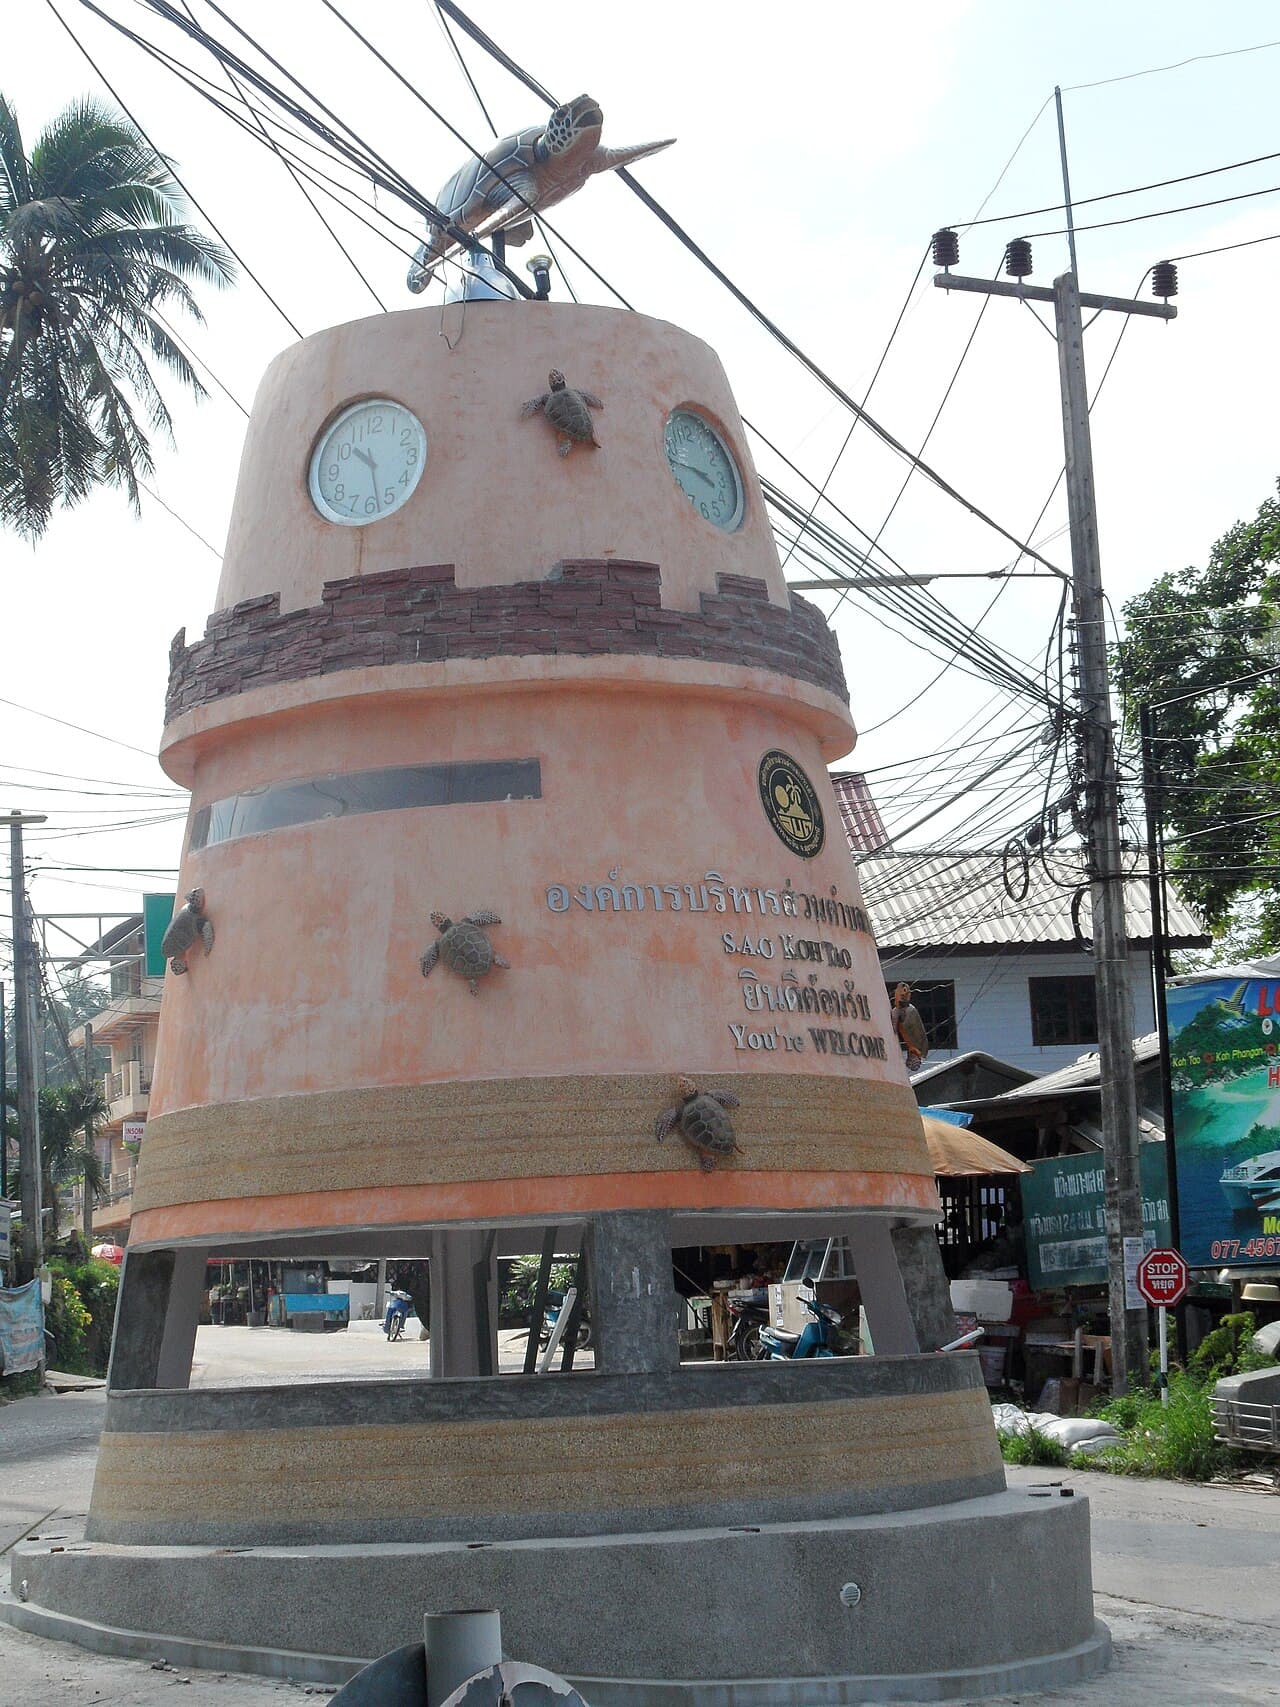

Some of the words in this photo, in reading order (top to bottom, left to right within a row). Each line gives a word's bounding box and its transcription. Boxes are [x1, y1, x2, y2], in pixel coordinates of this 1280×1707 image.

[351, 424, 364, 443] 11
[367, 415, 384, 435] 12
[400, 428, 412, 446] 2
[336, 442, 351, 461] 10
[406, 447, 417, 466] 3
[328, 464, 339, 482] 9
[398, 470, 410, 487] 4
[334, 483, 345, 501] 8
[383, 486, 396, 504] 5
[349, 494, 360, 512] 7
[364, 496, 376, 514] 6
[779, 933, 824, 963] KOH
[822, 940, 852, 970] TAO
[738, 967, 871, 1021] ยินดีต้อนรับ
[728, 1023, 804, 1052] You're
[808, 1026, 888, 1061] WELCOME
[1147, 1263, 1179, 1274] STOP
[1152, 1279, 1175, 1295] หยุด
